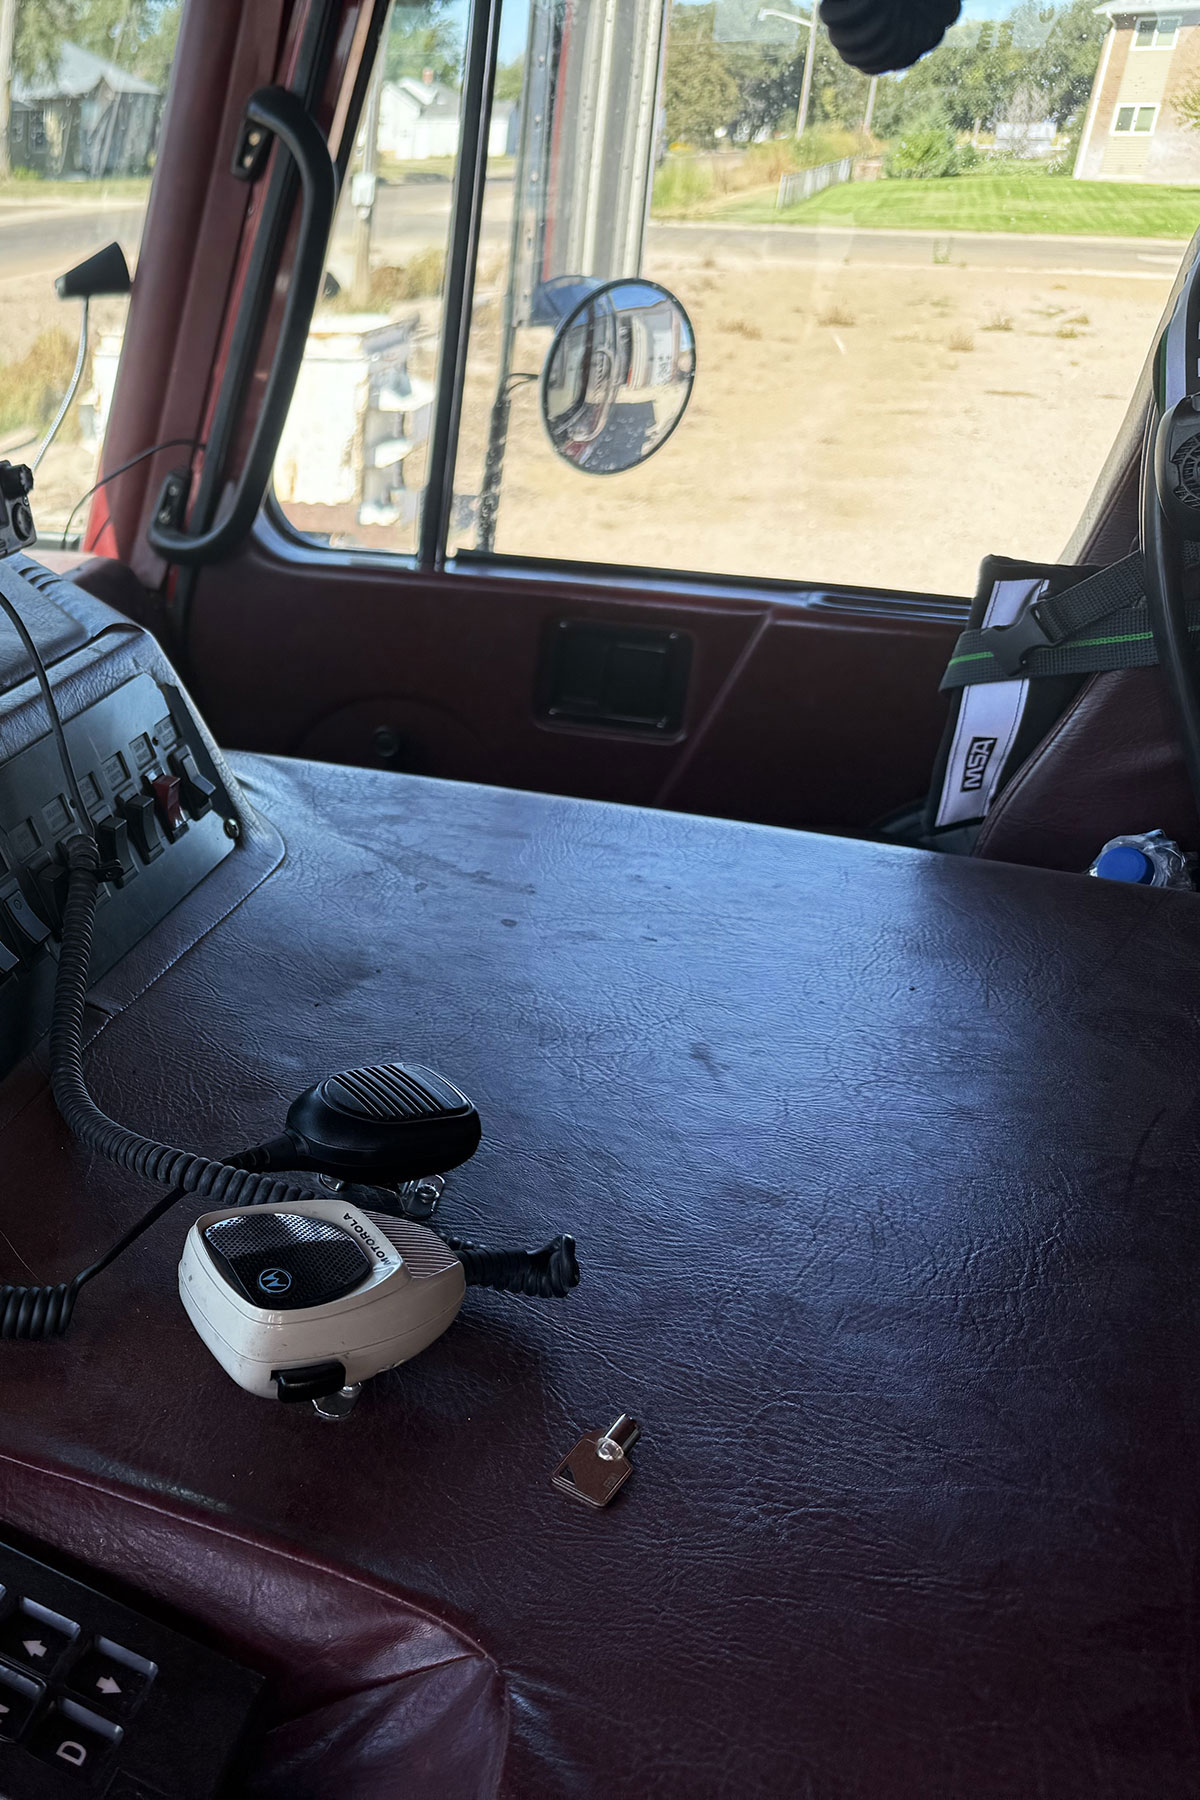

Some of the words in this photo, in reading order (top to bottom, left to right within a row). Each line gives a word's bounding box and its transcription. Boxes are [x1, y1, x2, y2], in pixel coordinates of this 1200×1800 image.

[964, 739, 996, 788] MSA
[342, 1212, 392, 1266] MOTOROLA
[55, 1740, 88, 1767] D
